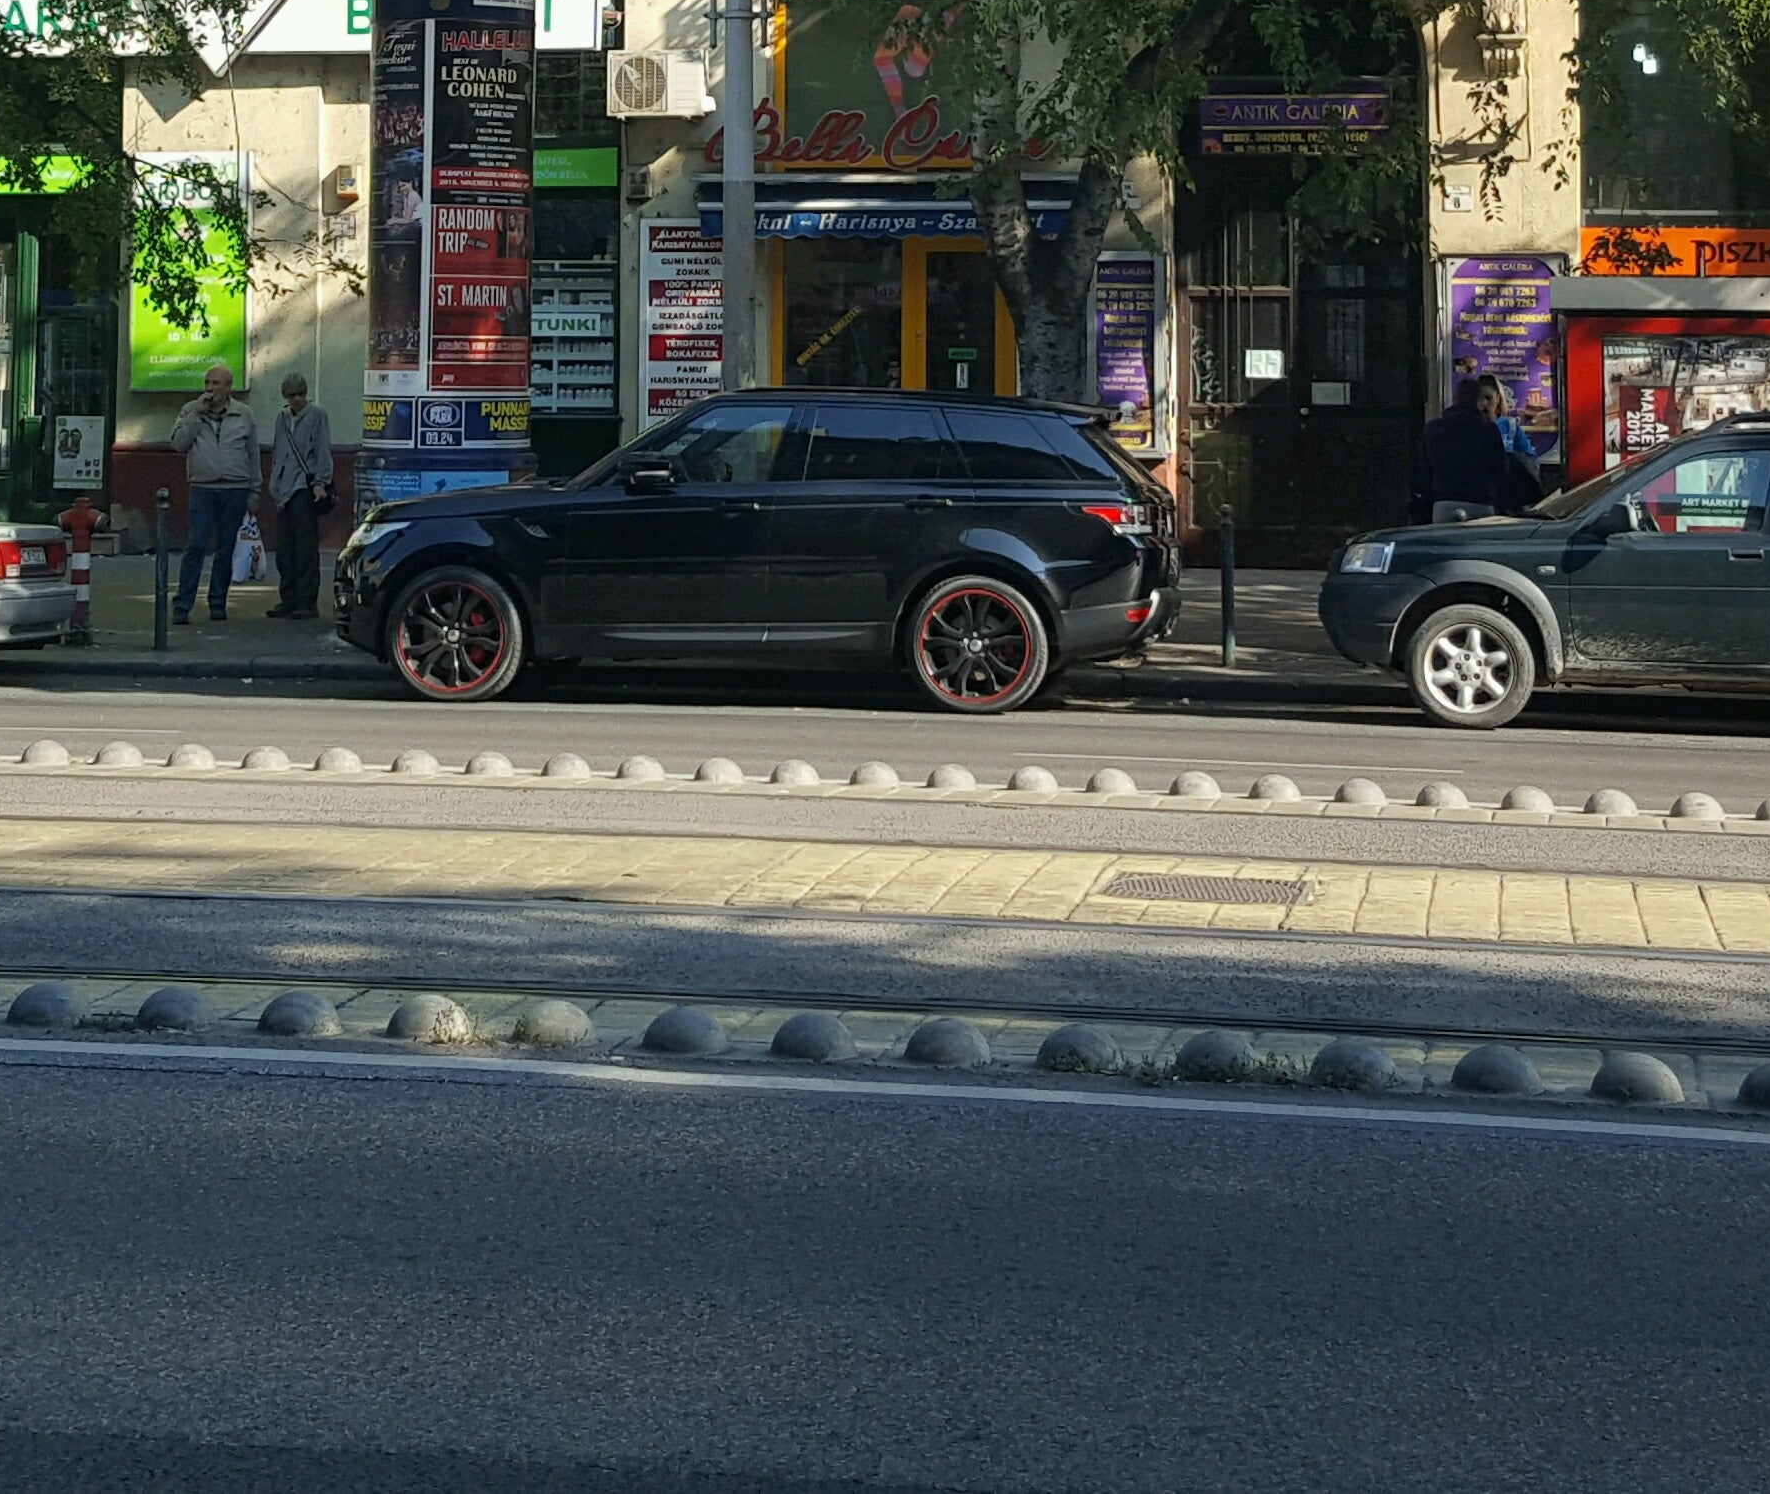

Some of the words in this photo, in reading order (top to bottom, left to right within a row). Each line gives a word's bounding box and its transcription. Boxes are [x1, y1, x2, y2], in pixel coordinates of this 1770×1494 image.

[441, 66, 518, 84] LEONARD
[447, 81, 505, 99] COHEN
[1231, 105, 1279, 120] ANTIK
[438, 208, 495, 231] RANDOM
[819, 212, 917, 234] Harisnya
[437, 231, 469, 253] TRIP
[660, 257, 684, 265] GUMI
[686, 256, 723, 266] NÉLKÜL
[675, 268, 711, 276] ZOKNIK
[436, 284, 458, 306] ST.
[460, 285, 508, 307] MARTIN
[695, 297, 723, 306] ZOKN
[1681, 498, 1700, 507] ART
